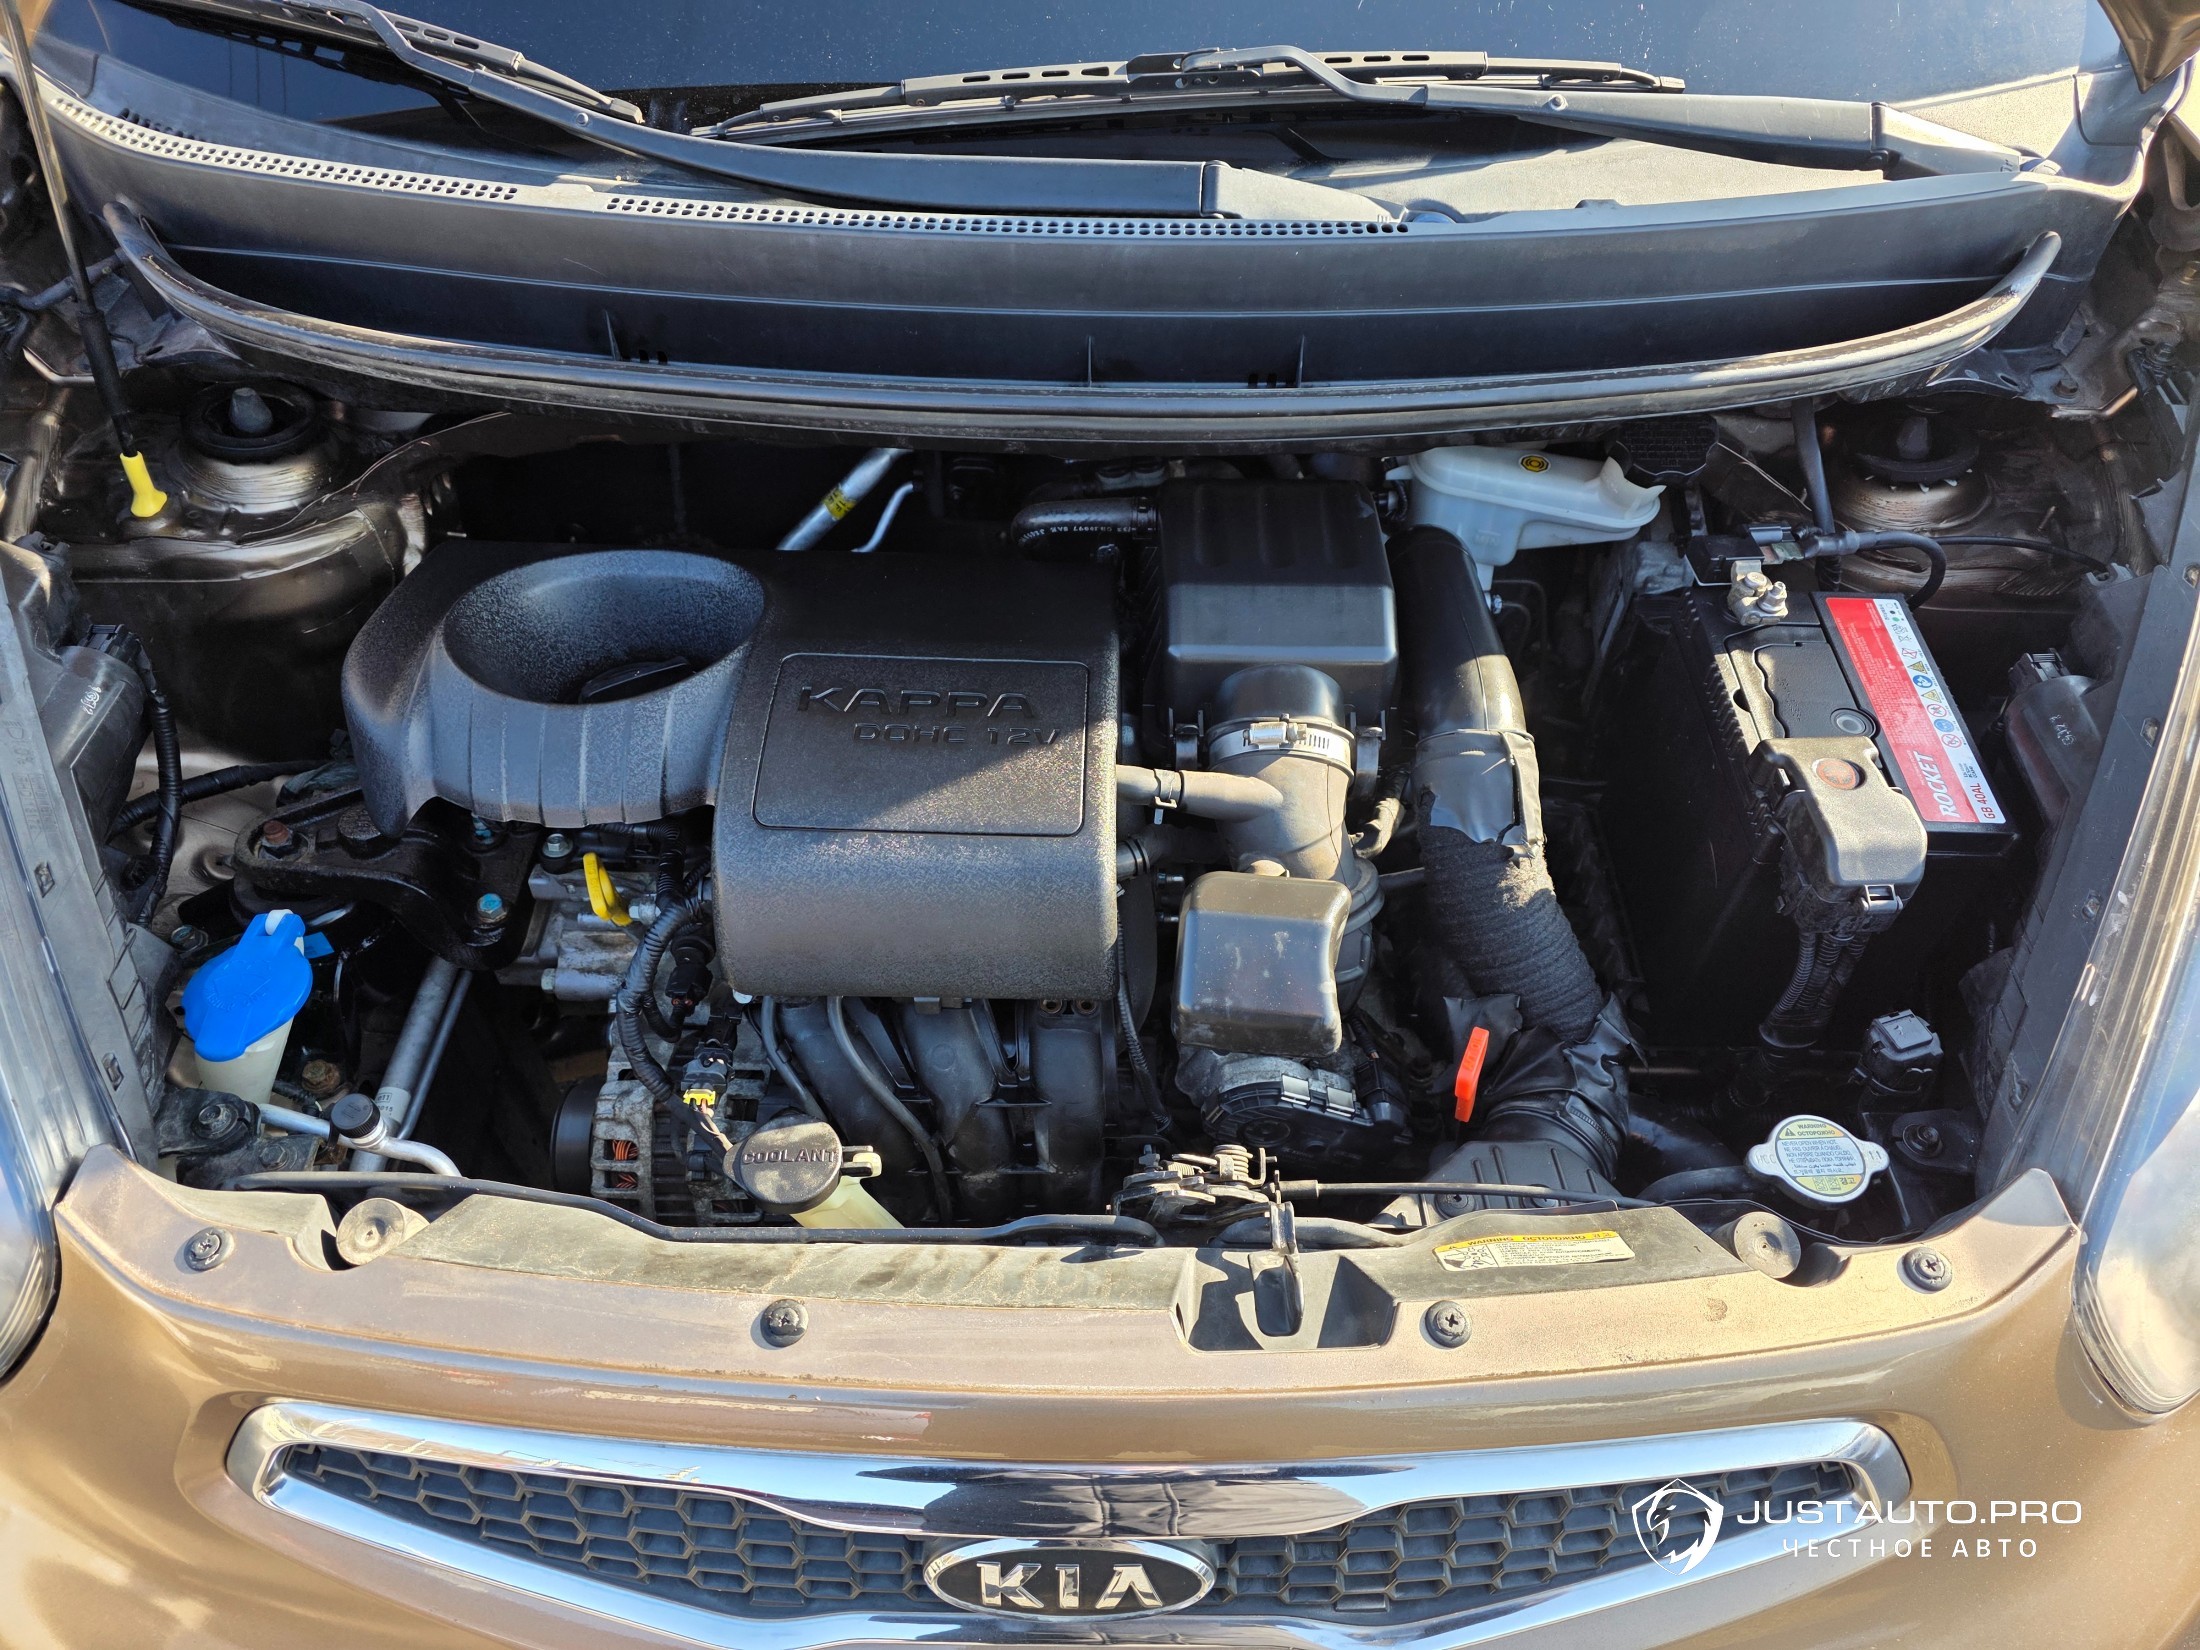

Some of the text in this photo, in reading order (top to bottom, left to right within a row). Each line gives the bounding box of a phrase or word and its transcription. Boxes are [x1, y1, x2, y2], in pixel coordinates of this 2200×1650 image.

[797, 686, 1035, 718] KAPPA
[853, 723, 1061, 745] DOHC 12V
[1913, 751, 1961, 818] ROCKET
[1970, 782, 1996, 819] GB 40AL
[742, 1148, 836, 1164] COOLANT
[1467, 1236, 1514, 1246] WARNING
[1522, 1234, 1586, 1242] ОСТОРОЖНО
[976, 1560, 1163, 1609] KIA
